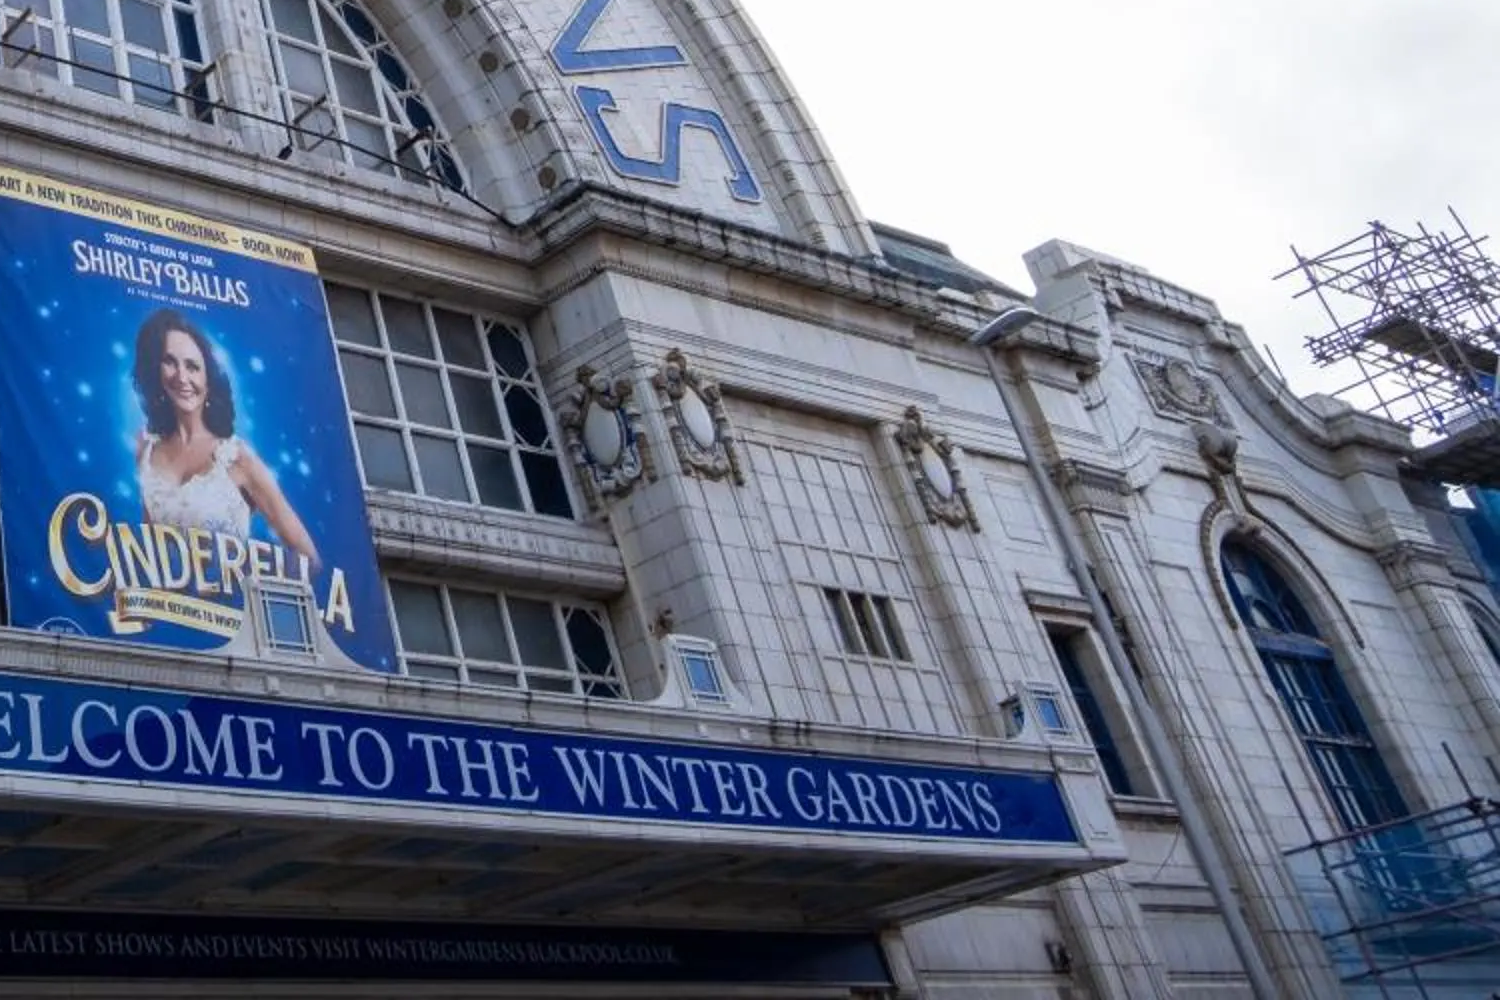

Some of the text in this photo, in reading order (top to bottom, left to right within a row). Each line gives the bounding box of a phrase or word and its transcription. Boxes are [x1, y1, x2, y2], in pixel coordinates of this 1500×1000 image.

[25, 181, 35, 197] A
[37, 185, 66, 204] NEW
[69, 193, 133, 221] TRADITION
[136, 210, 163, 229] THIS
[165, 217, 229, 245] CHRISTMAS
[241, 236, 274, 257] BOOK
[72, 239, 162, 288] SHIRLEY
[163, 262, 250, 307] BALLAS
[301, 720, 395, 791] TO
[408, 732, 540, 801] THE
[552, 747, 783, 820] WINTER
[787, 767, 1001, 833] GARDENS
[9, 929, 88, 955] LATEST
[95, 931, 175, 957] SHOWS
[180, 933, 228, 958] AND
[232, 934, 307, 960] EVENTS
[312, 936, 361, 960] VISIT
